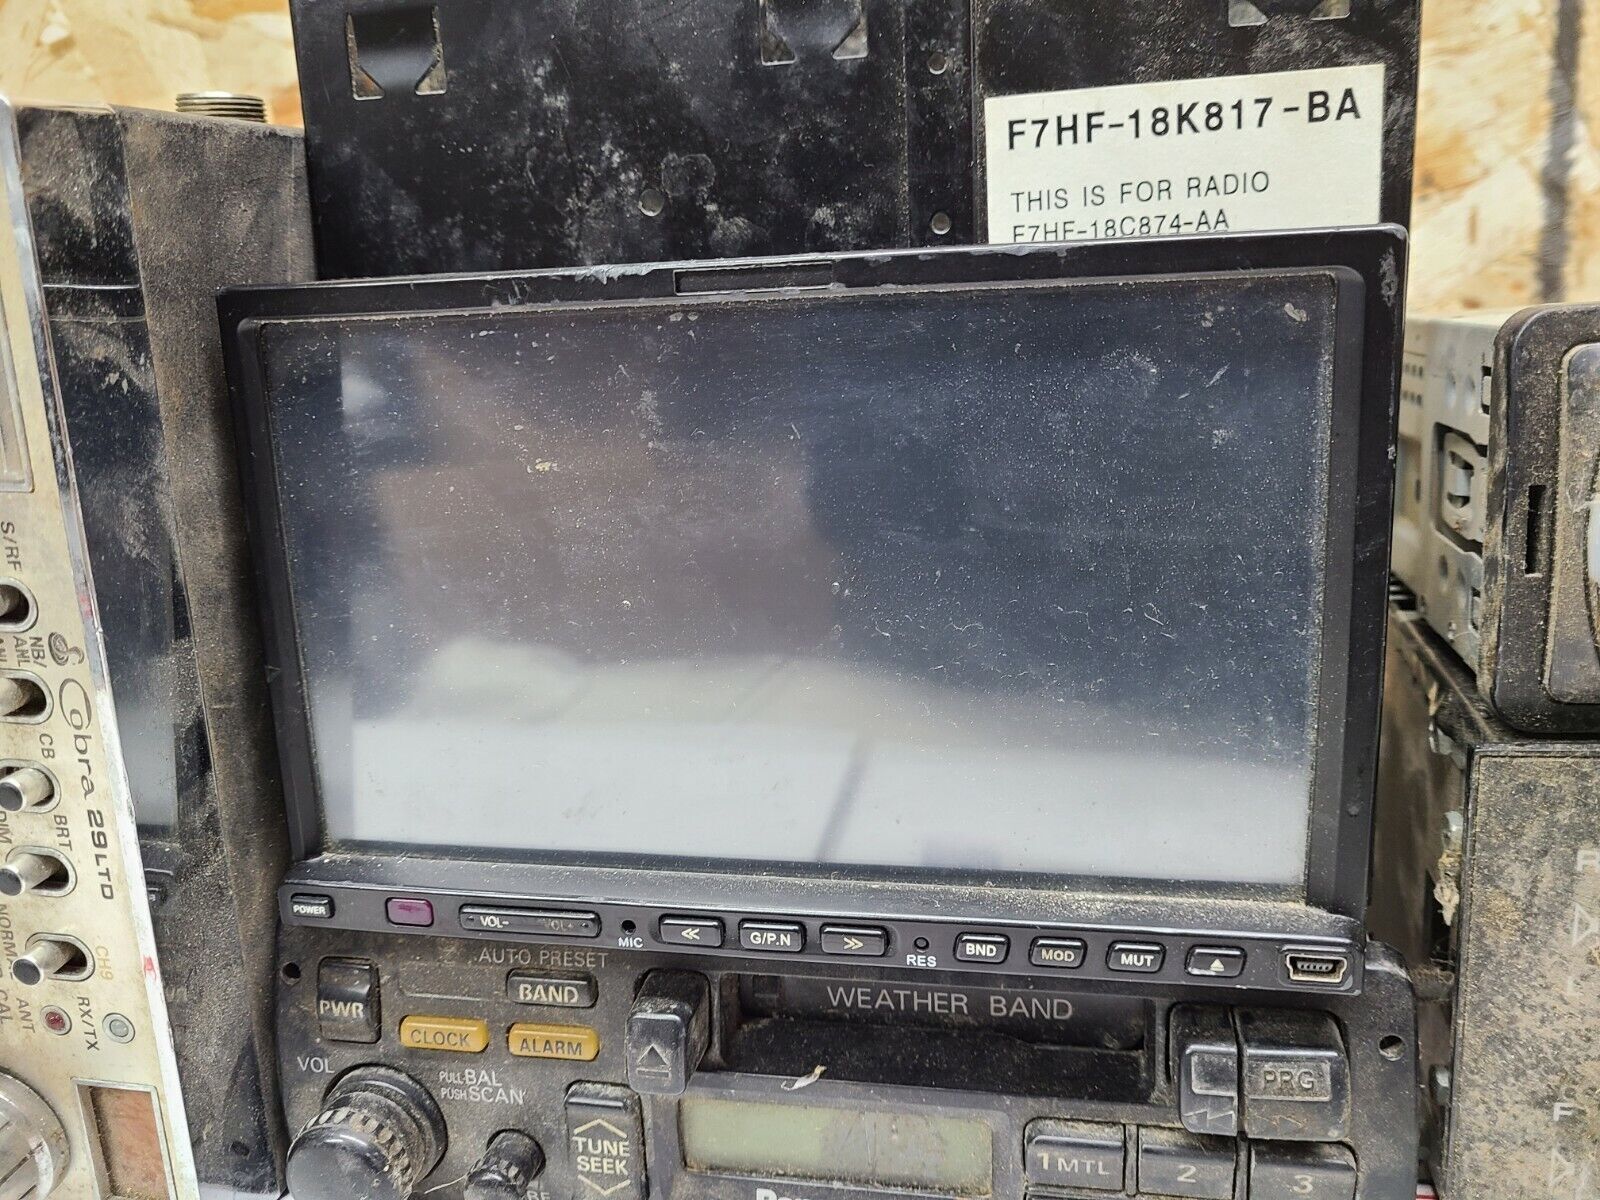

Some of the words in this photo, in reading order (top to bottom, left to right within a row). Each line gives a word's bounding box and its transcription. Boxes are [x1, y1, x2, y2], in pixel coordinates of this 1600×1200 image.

[1011, 189, 1068, 213] THIS
[1083, 184, 1105, 207] IS
[1120, 179, 1172, 204] FOR
[1187, 171, 1270, 198] RADIO
[1, 521, 22, 572] S/RF
[13, 635, 30, 667] ANL
[29, 636, 47, 668] NB/
[39, 733, 56, 760] CB
[59, 678, 95, 800] Cobra
[54, 814, 73, 851] BRT
[293, 904, 326, 916] POWER
[618, 937, 644, 948] MIC
[750, 931, 791, 946] G/P.N
[478, 949, 532, 965] AUTO
[539, 951, 609, 969] PRESET
[906, 954, 937, 967] RES
[965, 942, 997, 958] BND
[1041, 948, 1075, 964] MOD
[1120, 953, 1155, 968] MUT
[95, 945, 114, 981] CH9
[519, 983, 580, 1004] BAND
[827, 986, 969, 1016] WEATHER
[990, 995, 1074, 1021] BAND
[16, 997, 36, 1034] ANT
[320, 999, 365, 1019] PWR
[76, 996, 100, 1051] RX/TX
[411, 1029, 470, 1048] CLOCK
[520, 1037, 583, 1057] ALARM
[297, 1056, 335, 1075] VOL
[464, 1068, 503, 1087] BAL
[1263, 1070, 1316, 1091] PRG
[440, 1087, 468, 1101] PUSH
[468, 1086, 524, 1106] SCAN
[573, 1136, 630, 1157] TUNE
[577, 1155, 628, 1176] SEEK
[1037, 1152, 1051, 1171] 1
[1057, 1160, 1111, 1176] MTL
[1176, 1165, 1198, 1184] 2
[1293, 1174, 1314, 1195] 3
